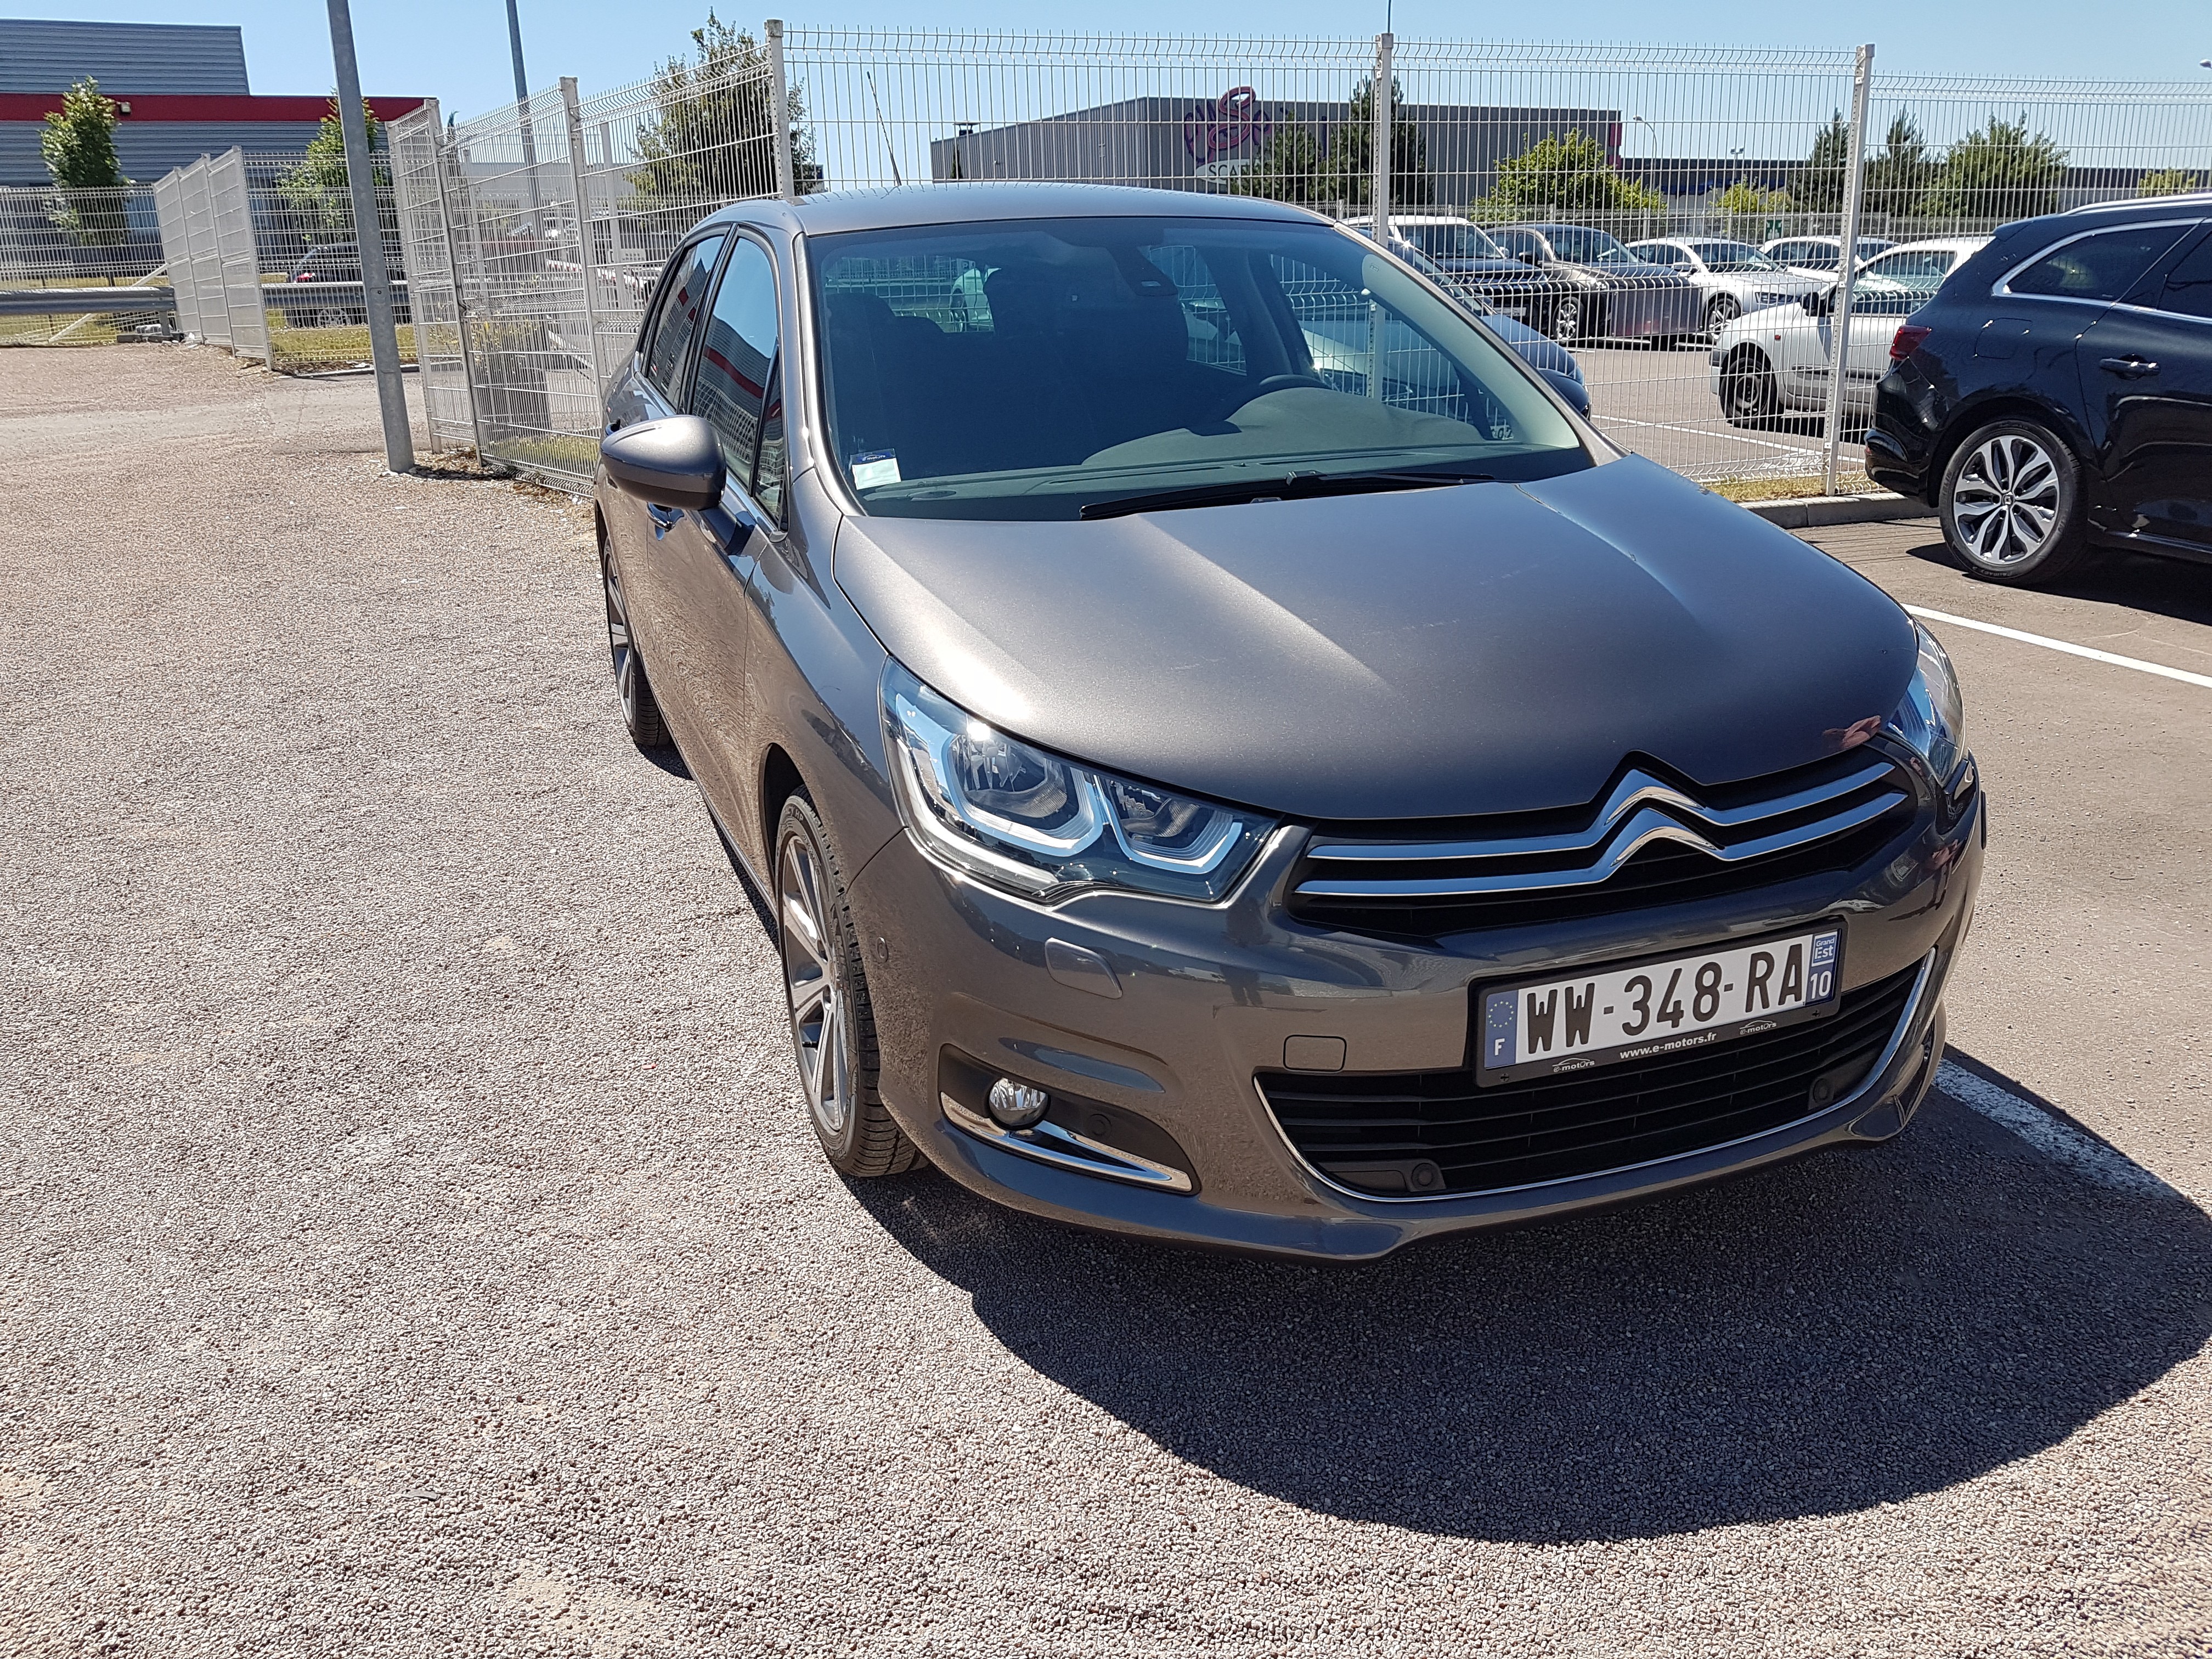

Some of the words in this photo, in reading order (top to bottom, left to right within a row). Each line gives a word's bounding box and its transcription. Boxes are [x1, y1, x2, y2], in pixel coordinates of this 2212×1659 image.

[1814, 945, 1834, 960] Est
[1816, 936, 1835, 947] Grand
[1810, 970, 1832, 999] 10
[1527, 943, 1803, 1054] WW-348-RA
[1494, 1038, 1505, 1056] F
[1620, 1032, 1717, 1059] www.e-motors.fr
